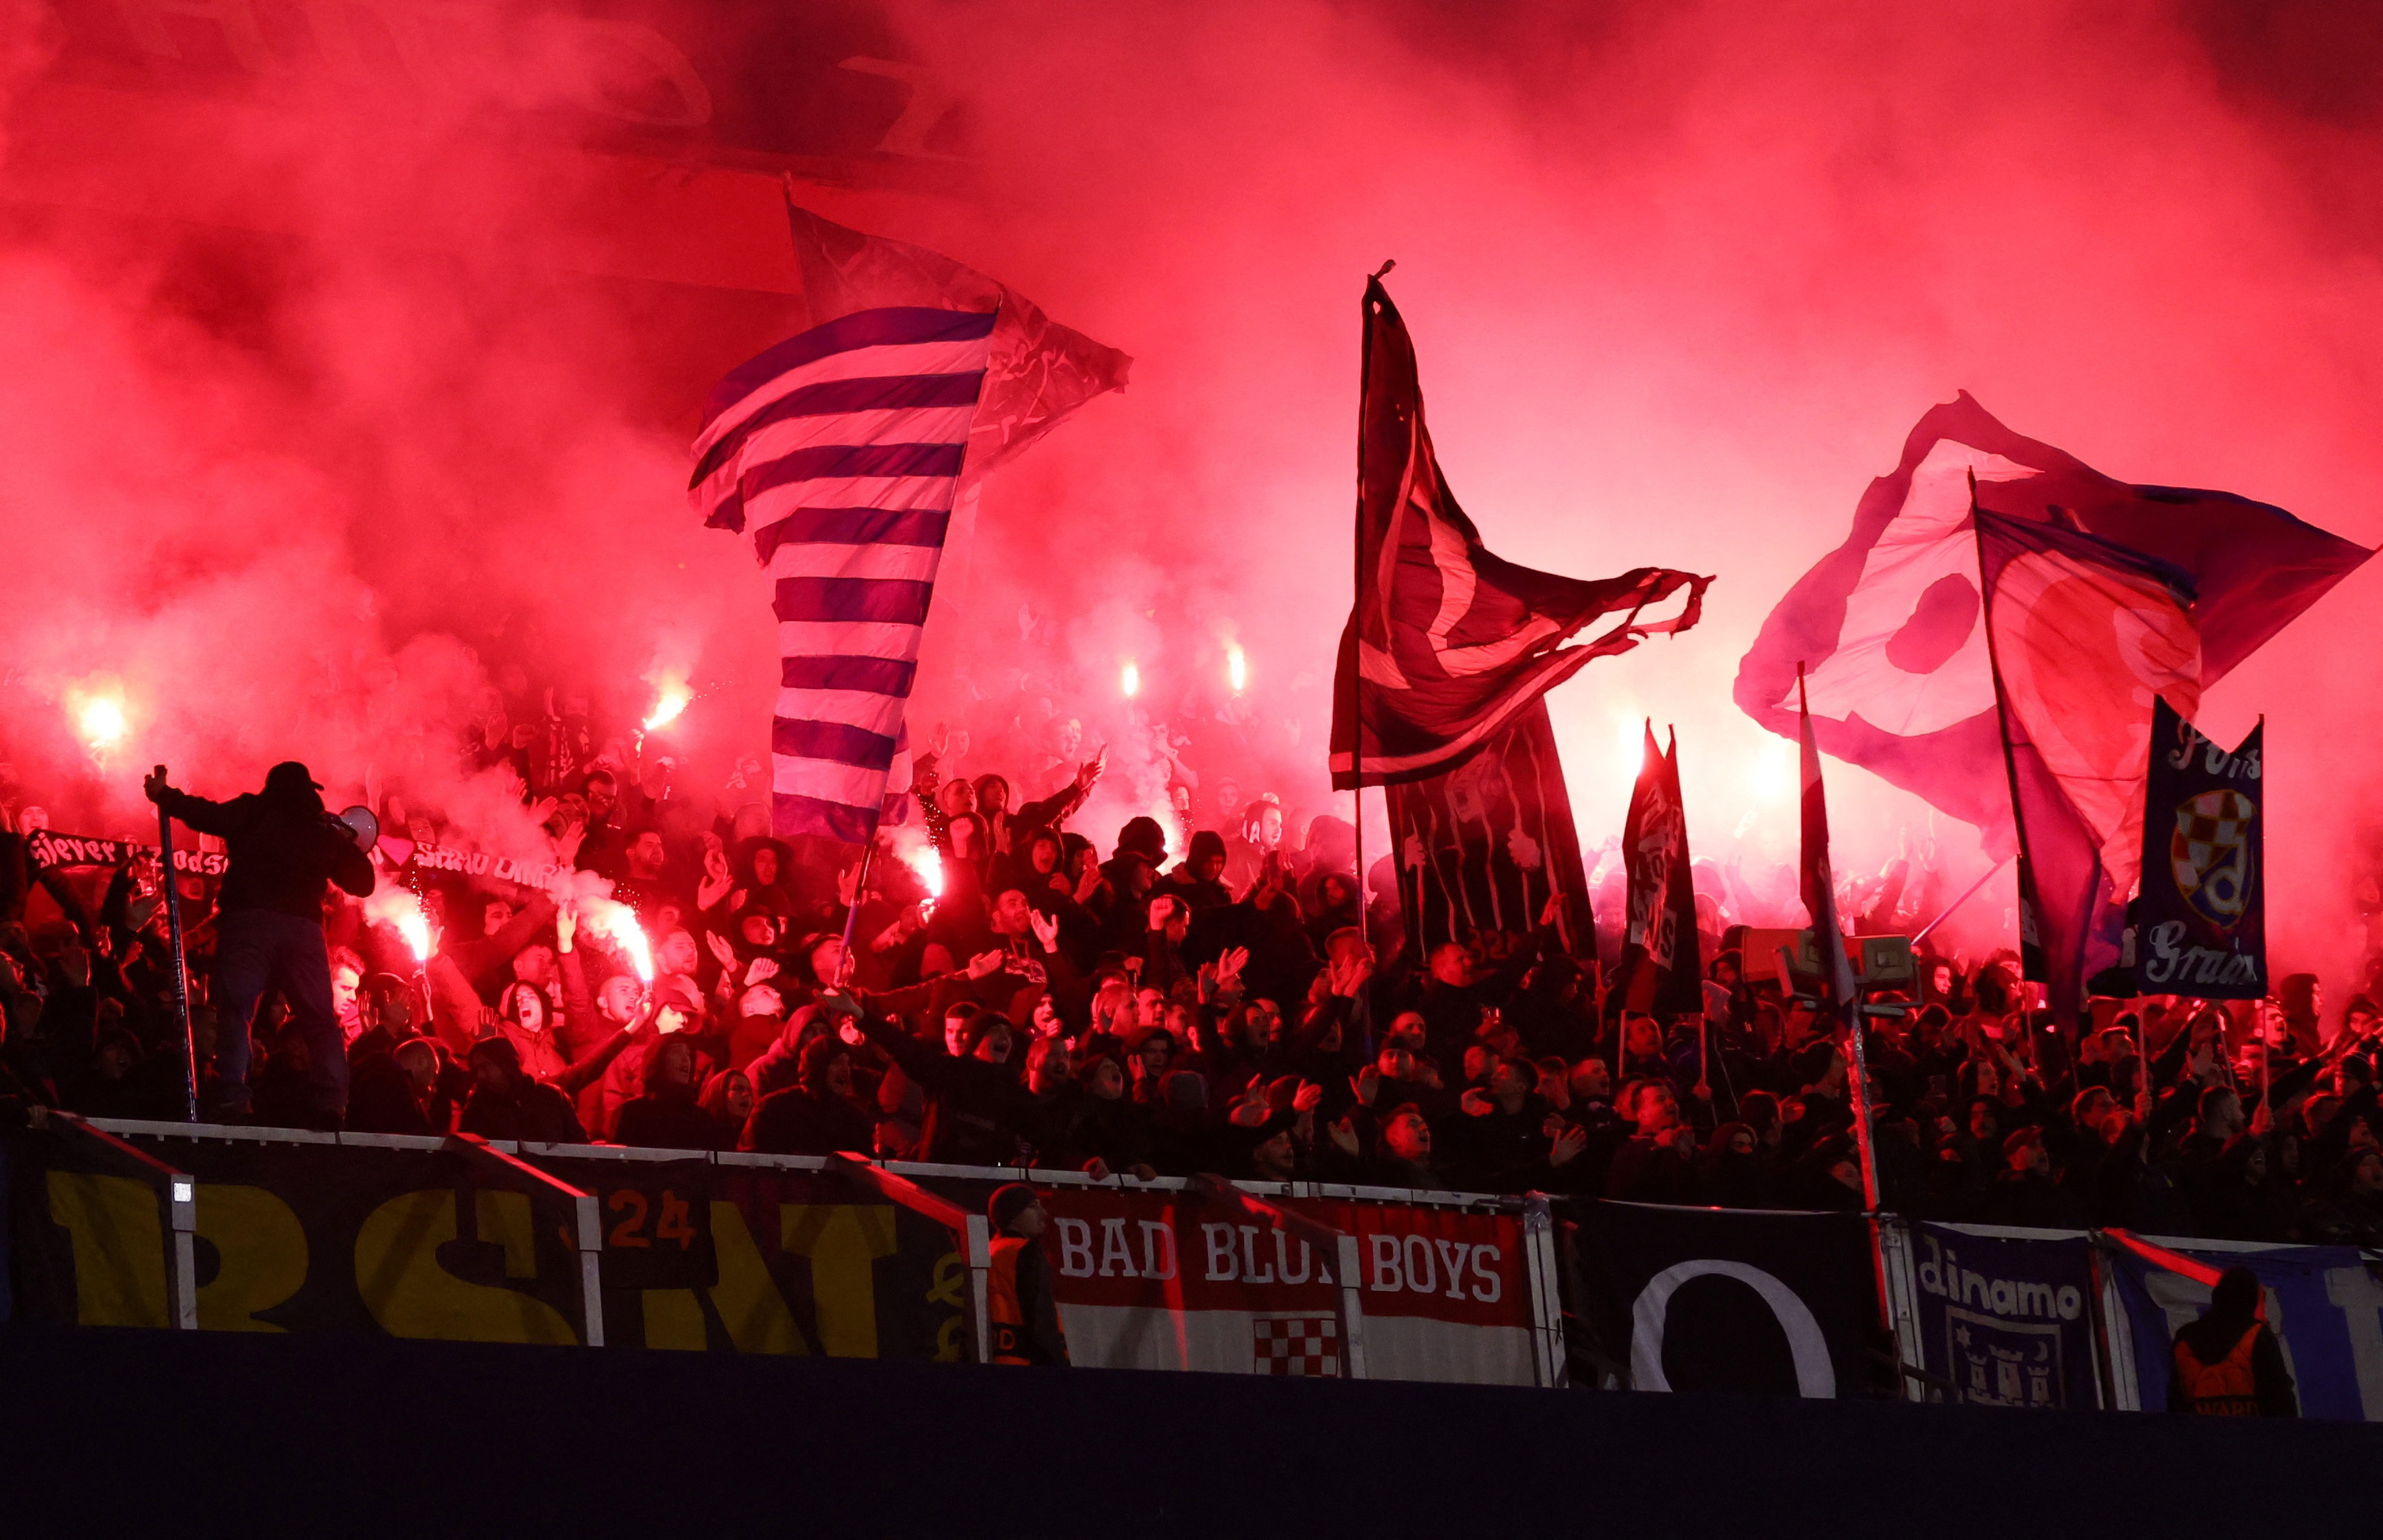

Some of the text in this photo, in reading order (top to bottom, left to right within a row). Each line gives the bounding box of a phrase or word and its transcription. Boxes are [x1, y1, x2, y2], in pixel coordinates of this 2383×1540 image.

[1055, 1217, 1502, 1303] BAD BLU BOYS
[1920, 1234, 2082, 1321] dinamo
